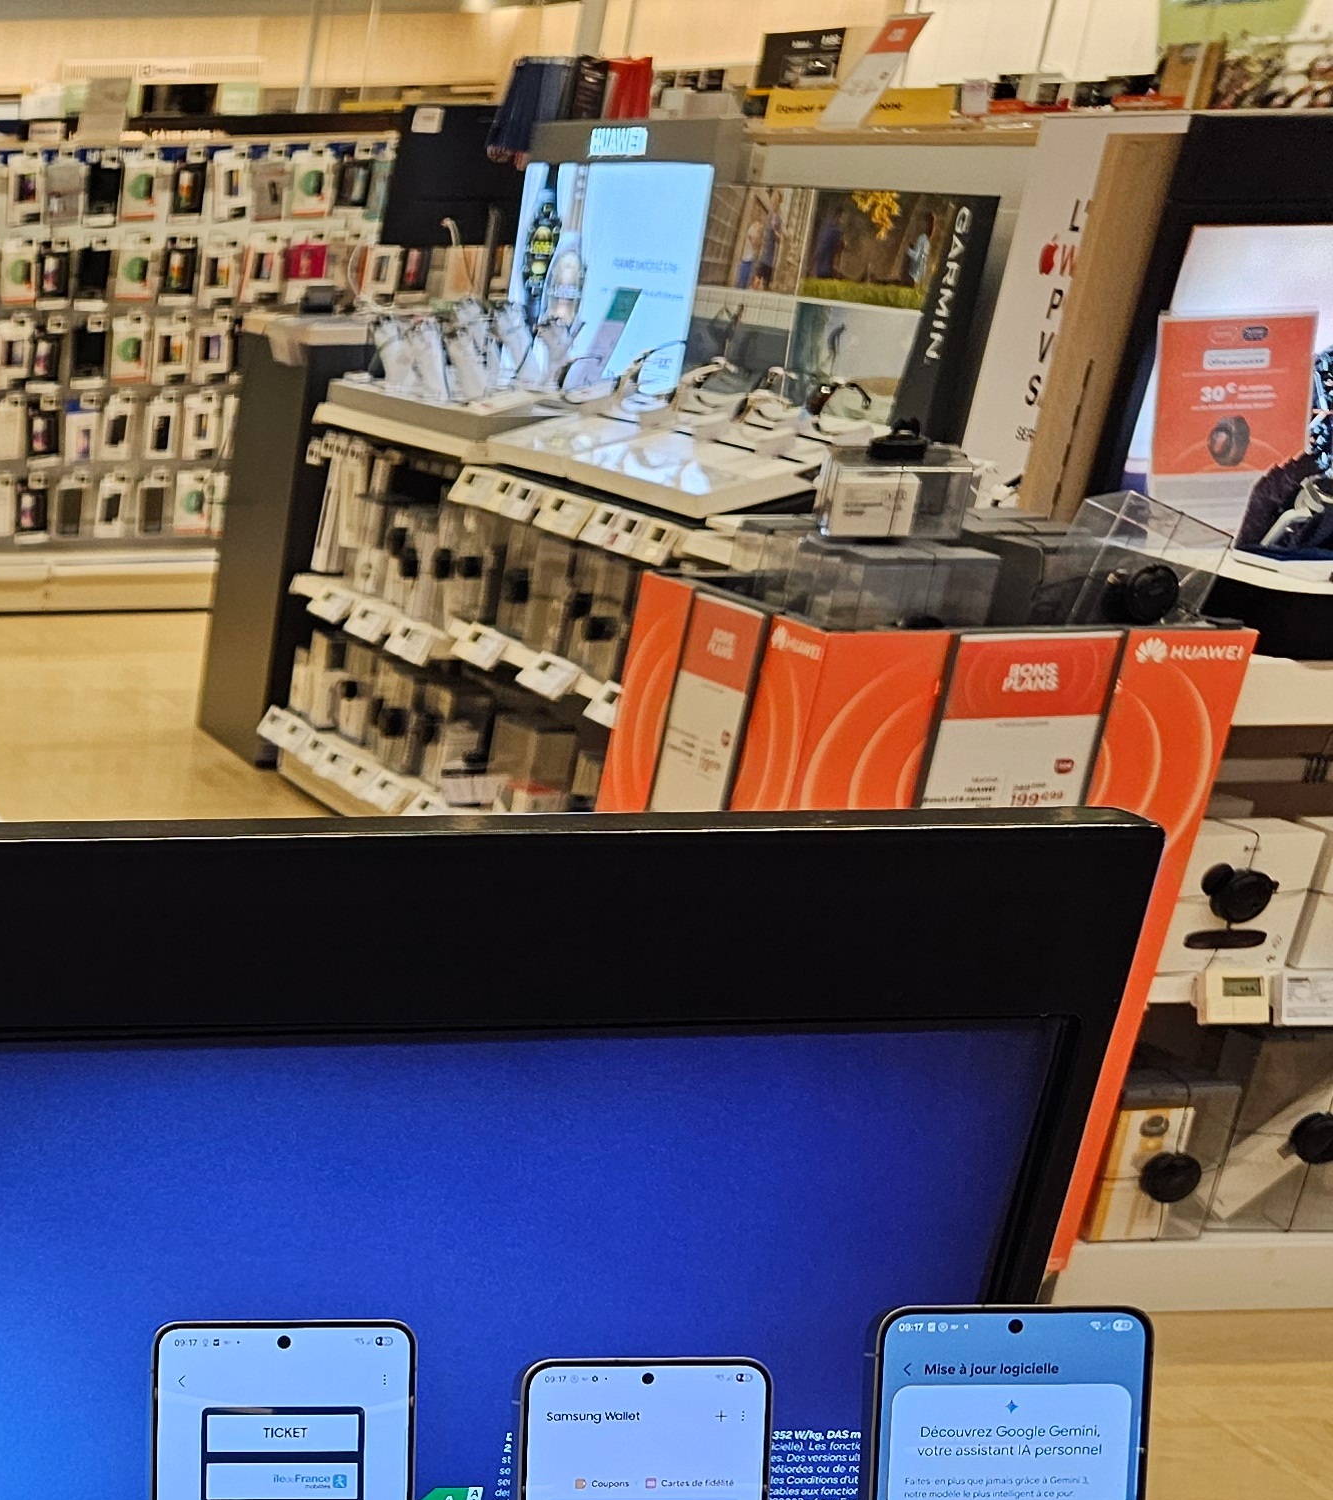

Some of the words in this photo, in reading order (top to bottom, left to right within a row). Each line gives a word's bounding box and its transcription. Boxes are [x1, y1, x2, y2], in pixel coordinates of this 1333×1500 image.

[591, 128, 648, 155] HUAWEI
[924, 206, 970, 361] GARMIN
[1170, 645, 1244, 660] HUAWEI
[1010, 662, 1059, 678] BONS
[1002, 677, 1059, 692] PLANS
[899, 1322, 923, 1332] 09:17
[174, 1339, 197, 1347] 09:17
[924, 1364, 956, 1375] Mise
[960, 1363, 967, 1374] à
[969, 1364, 996, 1377] jour
[1000, 1363, 1059, 1377] logicielle
[546, 1411, 601, 1424] Samsung
[604, 1411, 640, 1422] Wallet
[263, 1427, 307, 1439] TICKET
[920, 1427, 992, 1438] Découvrez
[996, 1427, 1045, 1440] Google
[1049, 1425, 1100, 1437] Gemini,
[918, 1447, 952, 1457] votre
[956, 1445, 1014, 1456] assistant
[1018, 1445, 1031, 1455] IA
[1035, 1445, 1102, 1458] personnel
[295, 1474, 331, 1484] France
[591, 1479, 629, 1490] Coupons
[661, 1479, 687, 1489] Cartes
[690, 1479, 701, 1489] de
[704, 1478, 734, 1489] fidélité
